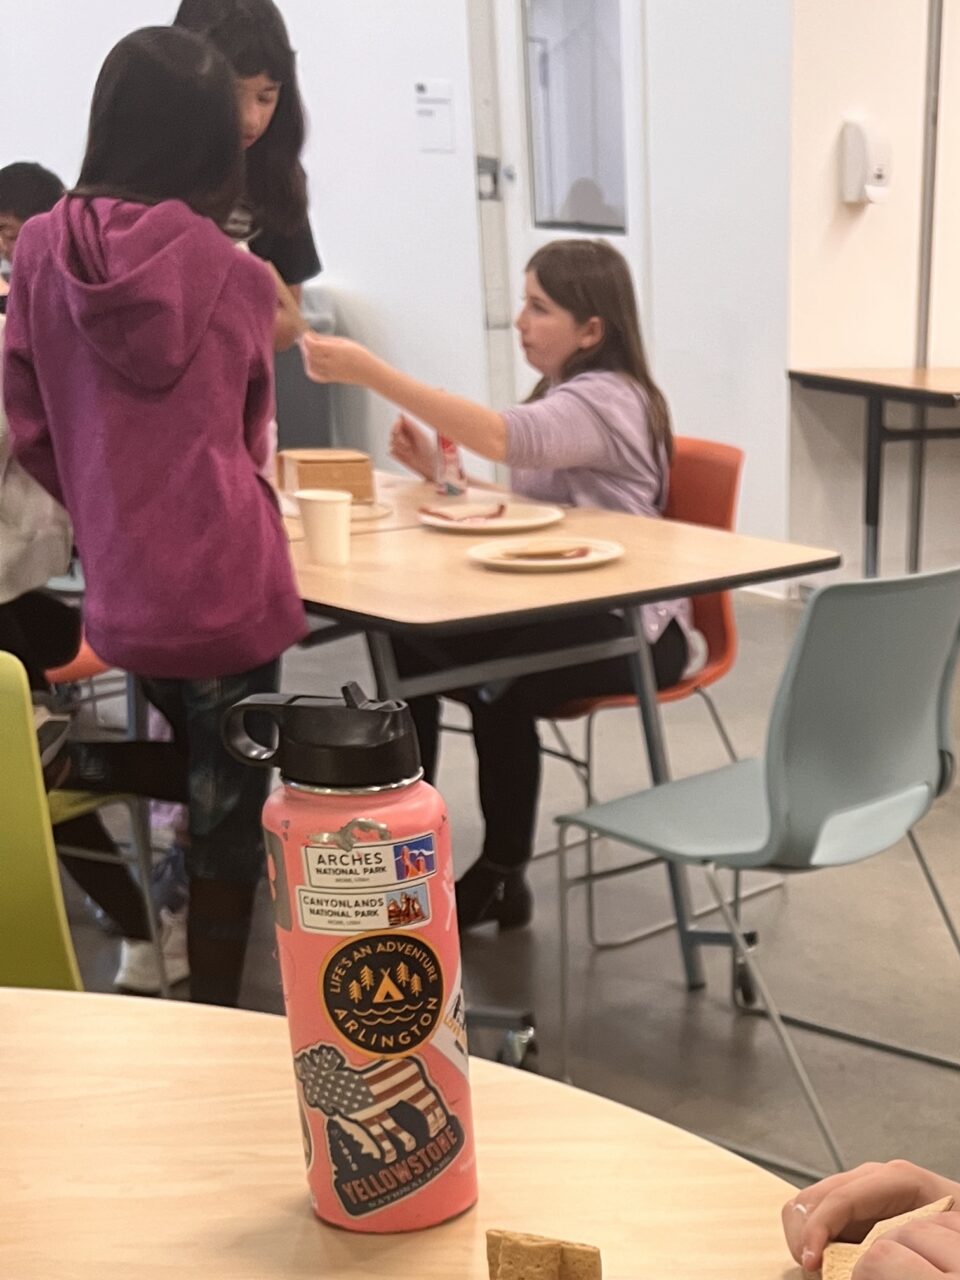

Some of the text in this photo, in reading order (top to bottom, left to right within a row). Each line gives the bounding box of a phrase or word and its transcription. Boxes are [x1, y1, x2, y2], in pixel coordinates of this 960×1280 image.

[317, 852, 383, 866] ARCHES
[315, 866, 387, 875] NATIONAL PARK
[303, 896, 384, 908] CANYONLANDS
[309, 908, 379, 918] NATIONAL PARK
[330, 942, 438, 993] LIFE'S AN ADVENTURE
[334, 997, 439, 1048] ARLINGTON
[341, 1124, 458, 1205] YELLOWSTONE
